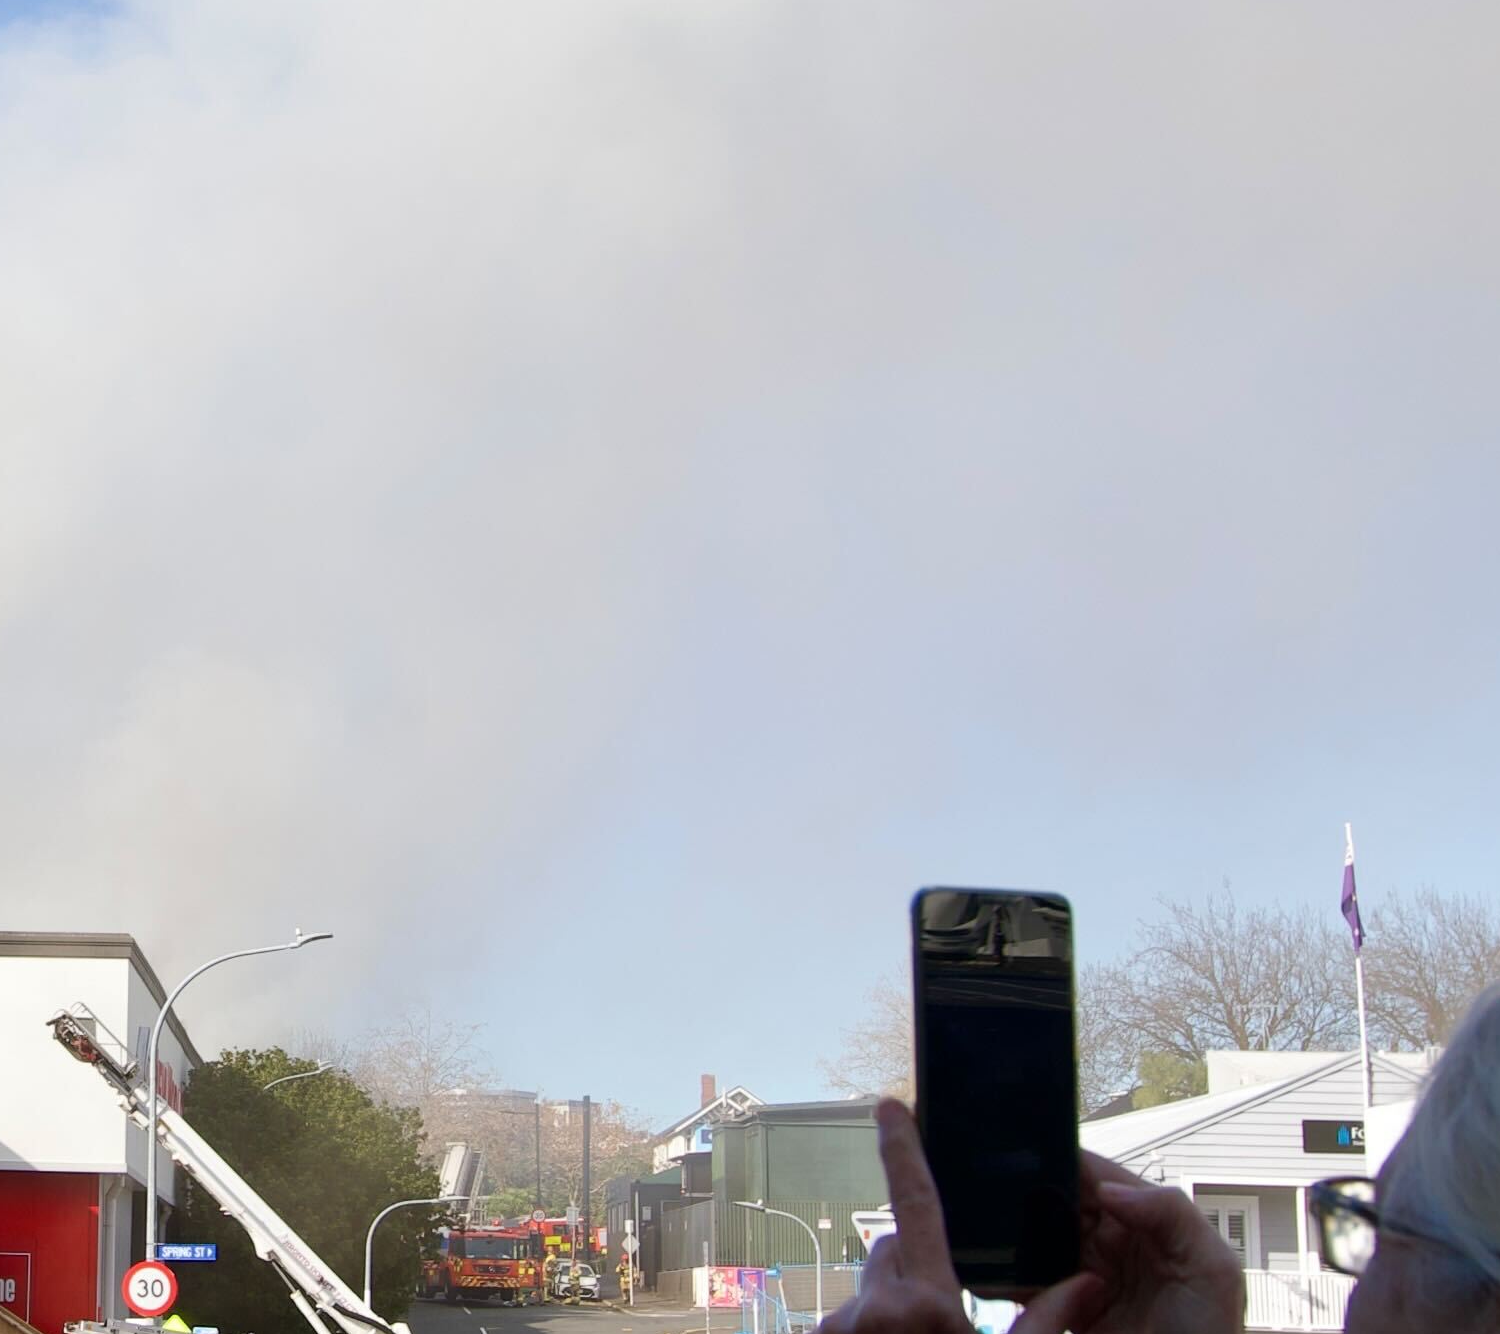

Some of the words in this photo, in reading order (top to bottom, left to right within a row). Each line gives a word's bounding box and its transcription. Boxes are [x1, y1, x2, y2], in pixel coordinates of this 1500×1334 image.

[161, 1246, 192, 1258] SPRING
[194, 1246, 206, 1258] ST
[136, 1279, 164, 1298] 30
